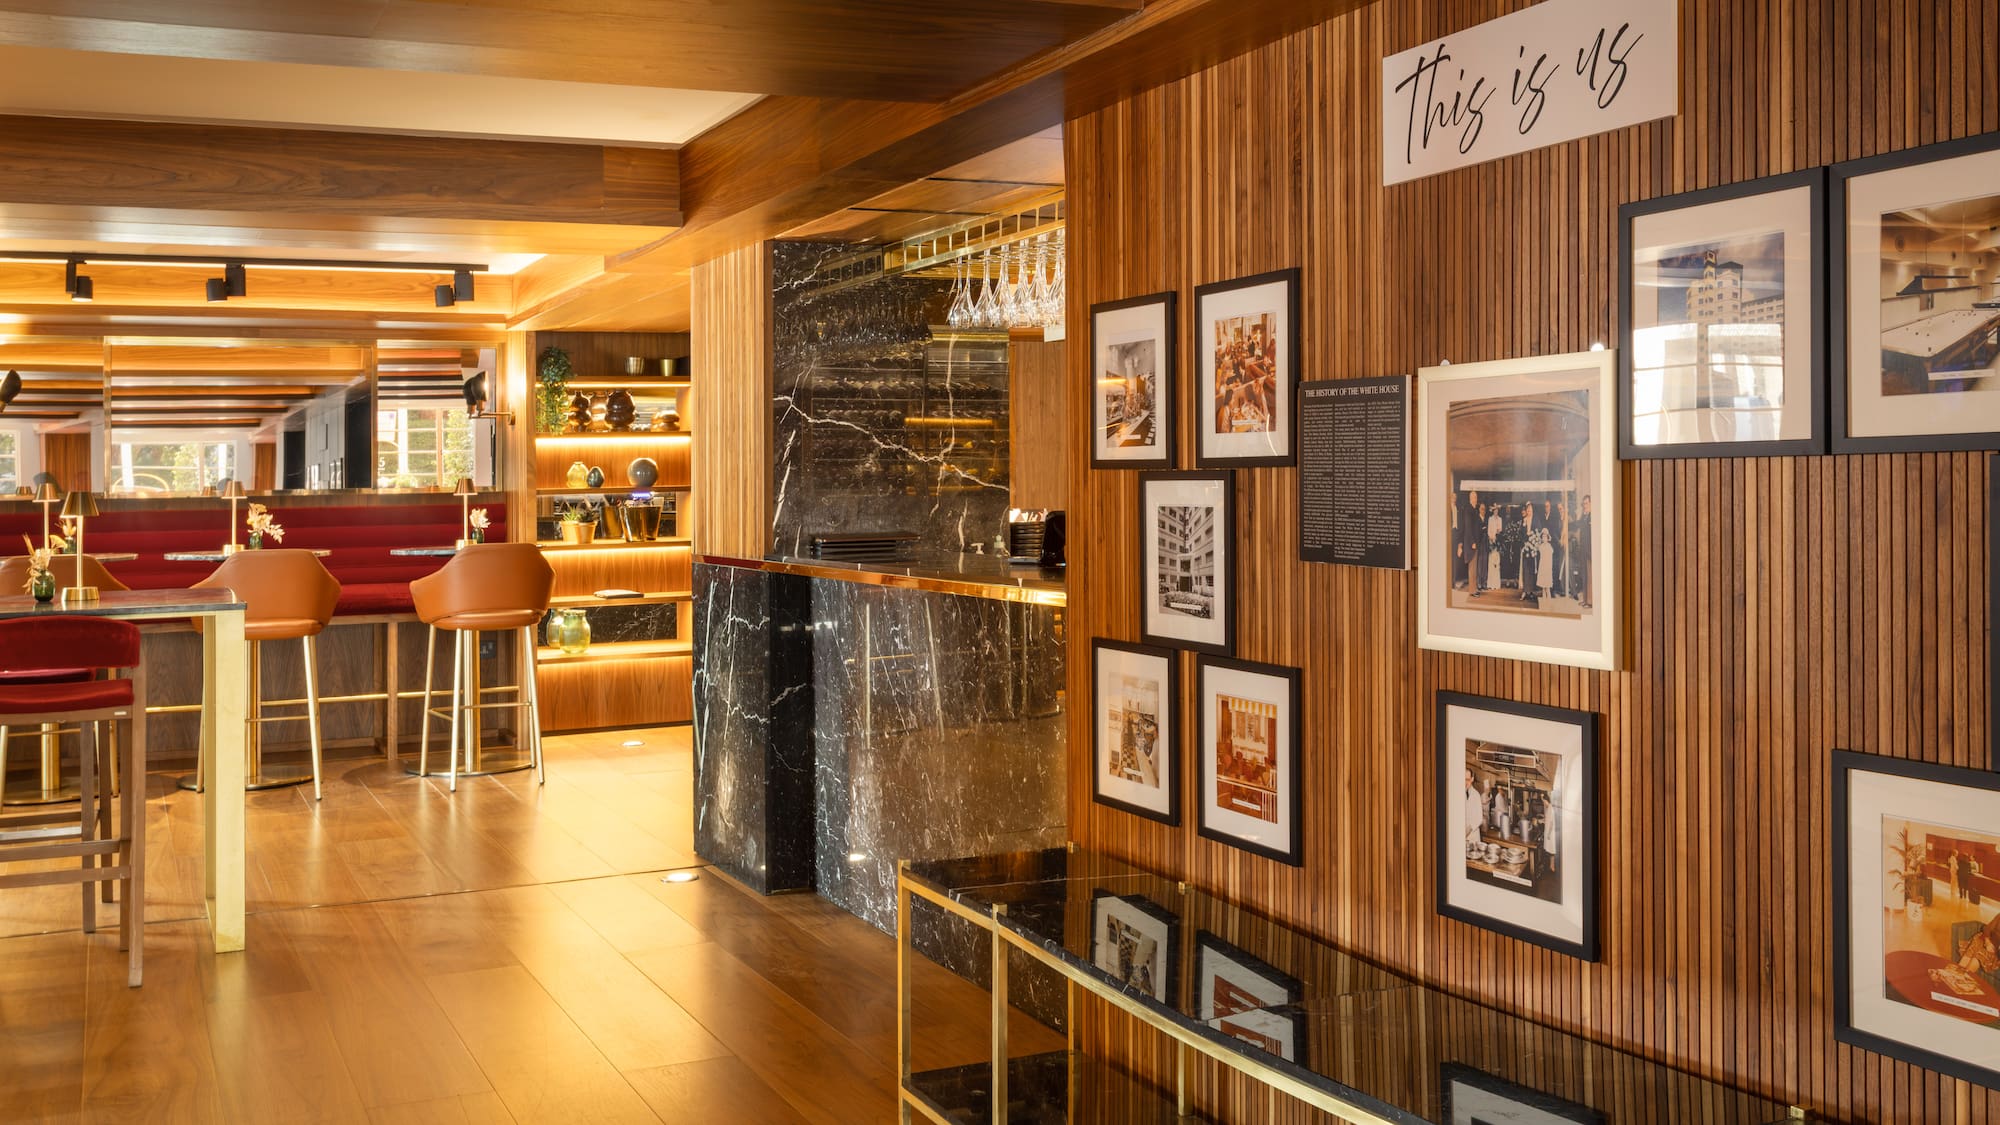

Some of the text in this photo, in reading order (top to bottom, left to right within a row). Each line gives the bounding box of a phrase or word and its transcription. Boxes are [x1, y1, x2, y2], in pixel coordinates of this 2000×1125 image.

[1512, 46, 1560, 134] is
[1576, 23, 1644, 109] us
[1305, 384, 1399, 397] THE HISTORY OF THE WHITE HOUSE
